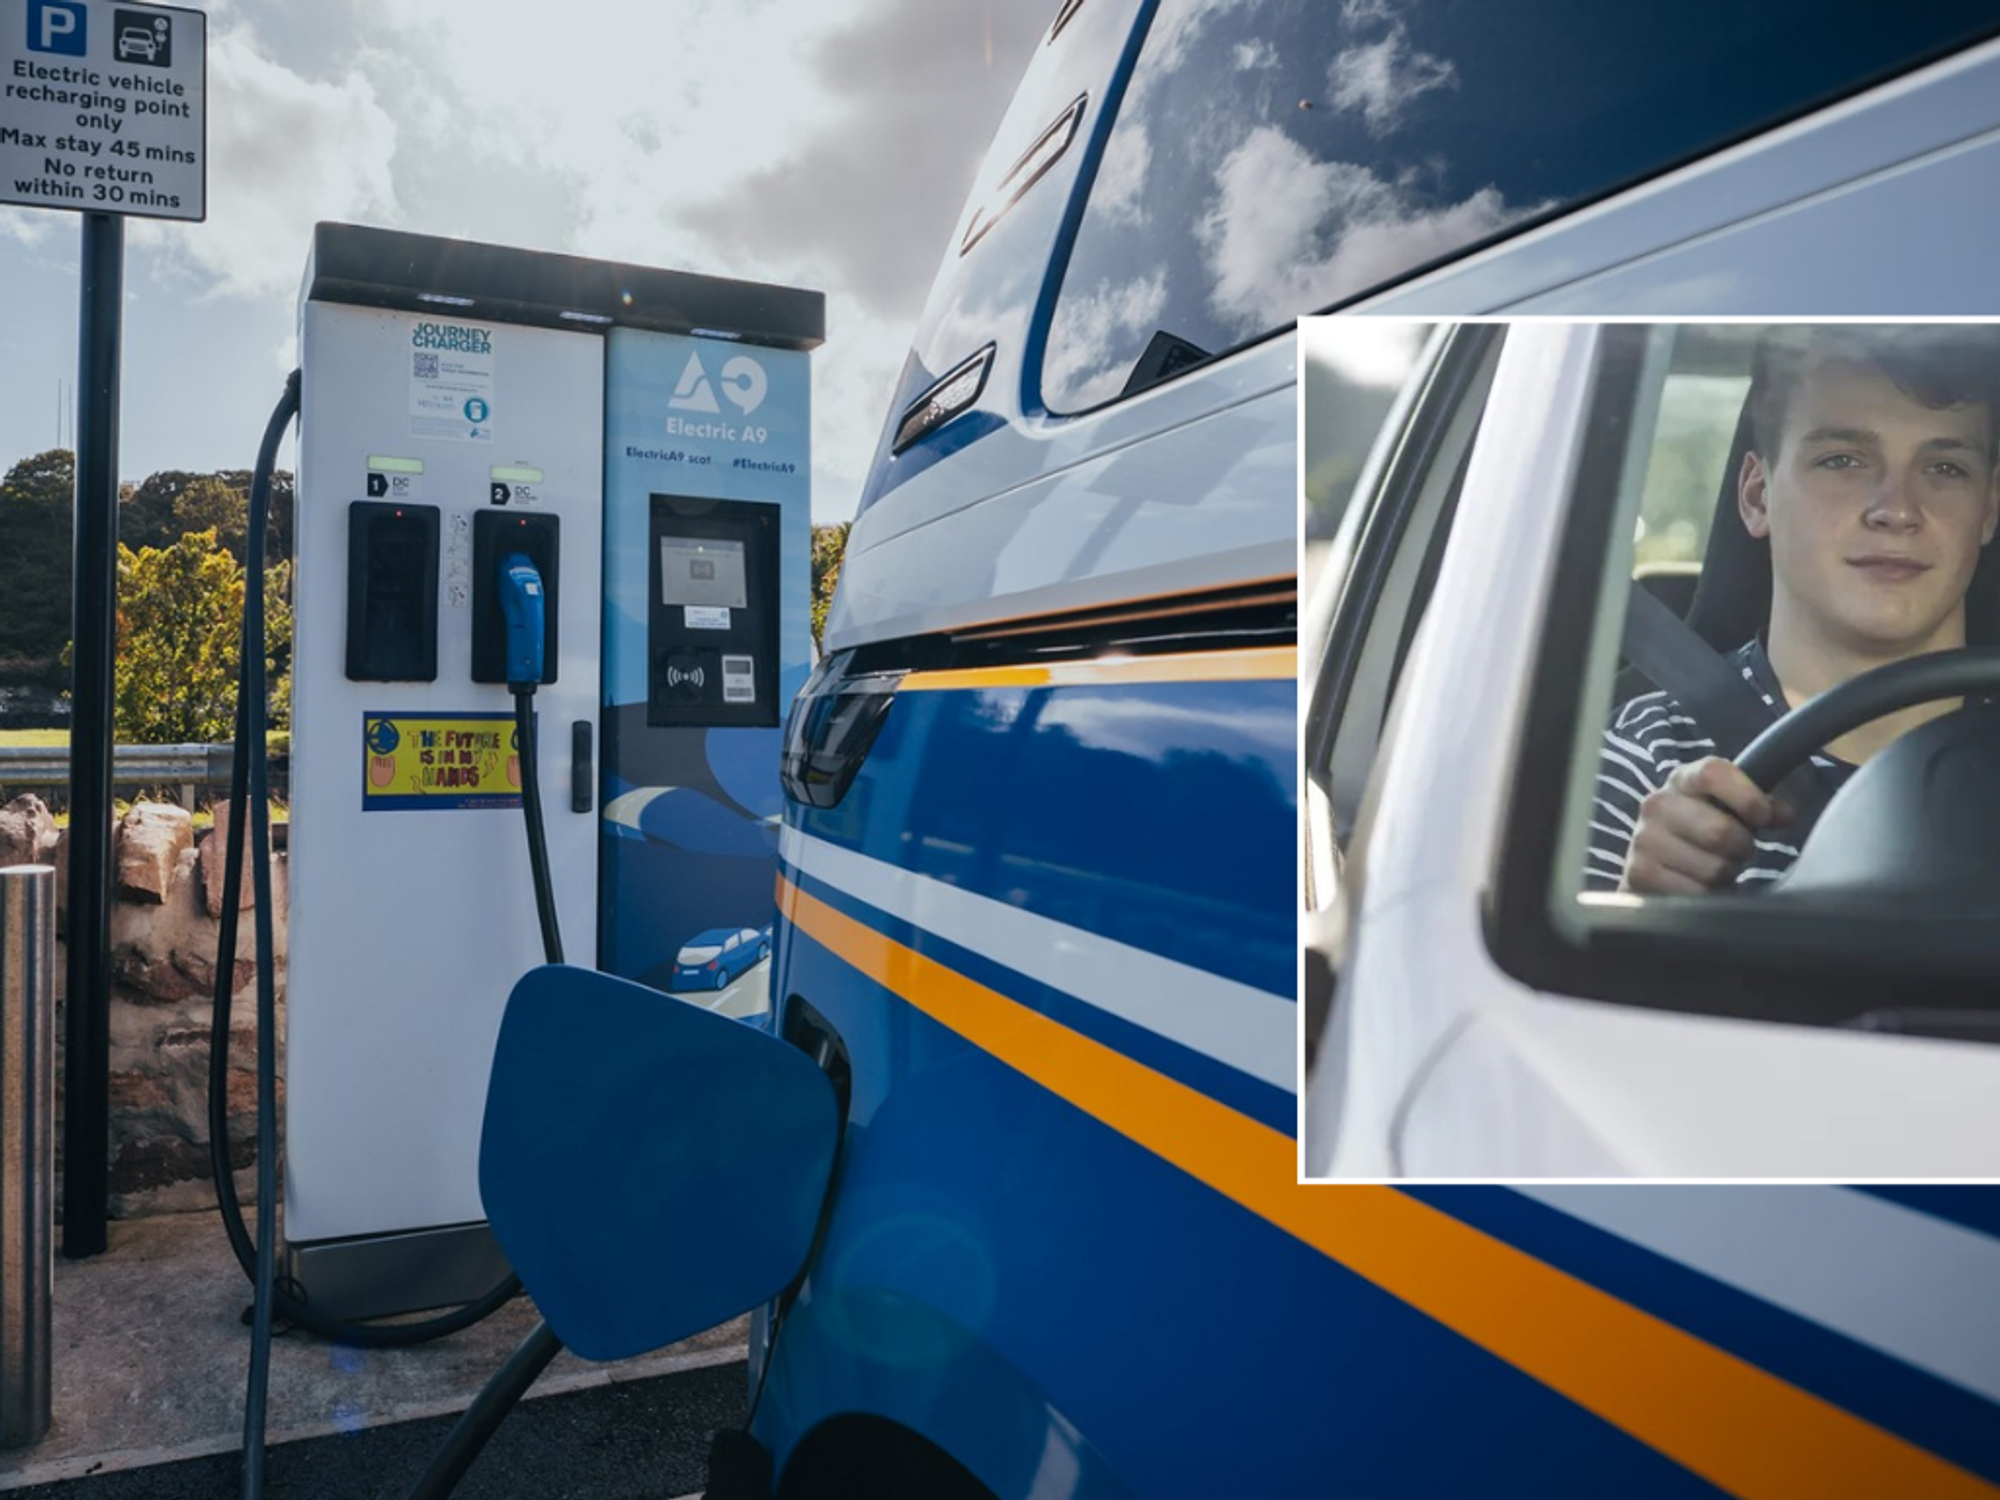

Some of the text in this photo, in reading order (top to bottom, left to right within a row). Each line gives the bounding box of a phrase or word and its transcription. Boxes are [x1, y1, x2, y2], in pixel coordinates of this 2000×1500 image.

[41, 5, 76, 49] P
[13, 60, 185, 97] Electric vehicle
[5, 84, 190, 119] recharging point
[75, 113, 123, 134] only
[0, 127, 196, 165] Max stay 45 mins
[44, 157, 154, 185] No return
[14, 177, 180, 208] within 30 mins
[412, 322, 492, 343] JOURNEY
[412, 334, 492, 355] CHARGER
[665, 416, 768, 445] Electric A9
[732, 457, 796, 474] #ElectricA9
[372, 476, 410, 492] 1 DC
[494, 487, 505, 500] 2
[515, 486, 531, 496] DC
[406, 729, 501, 750] THE FUTURE
[419, 749, 435, 765] IS
[422, 765, 480, 788] HANDS
